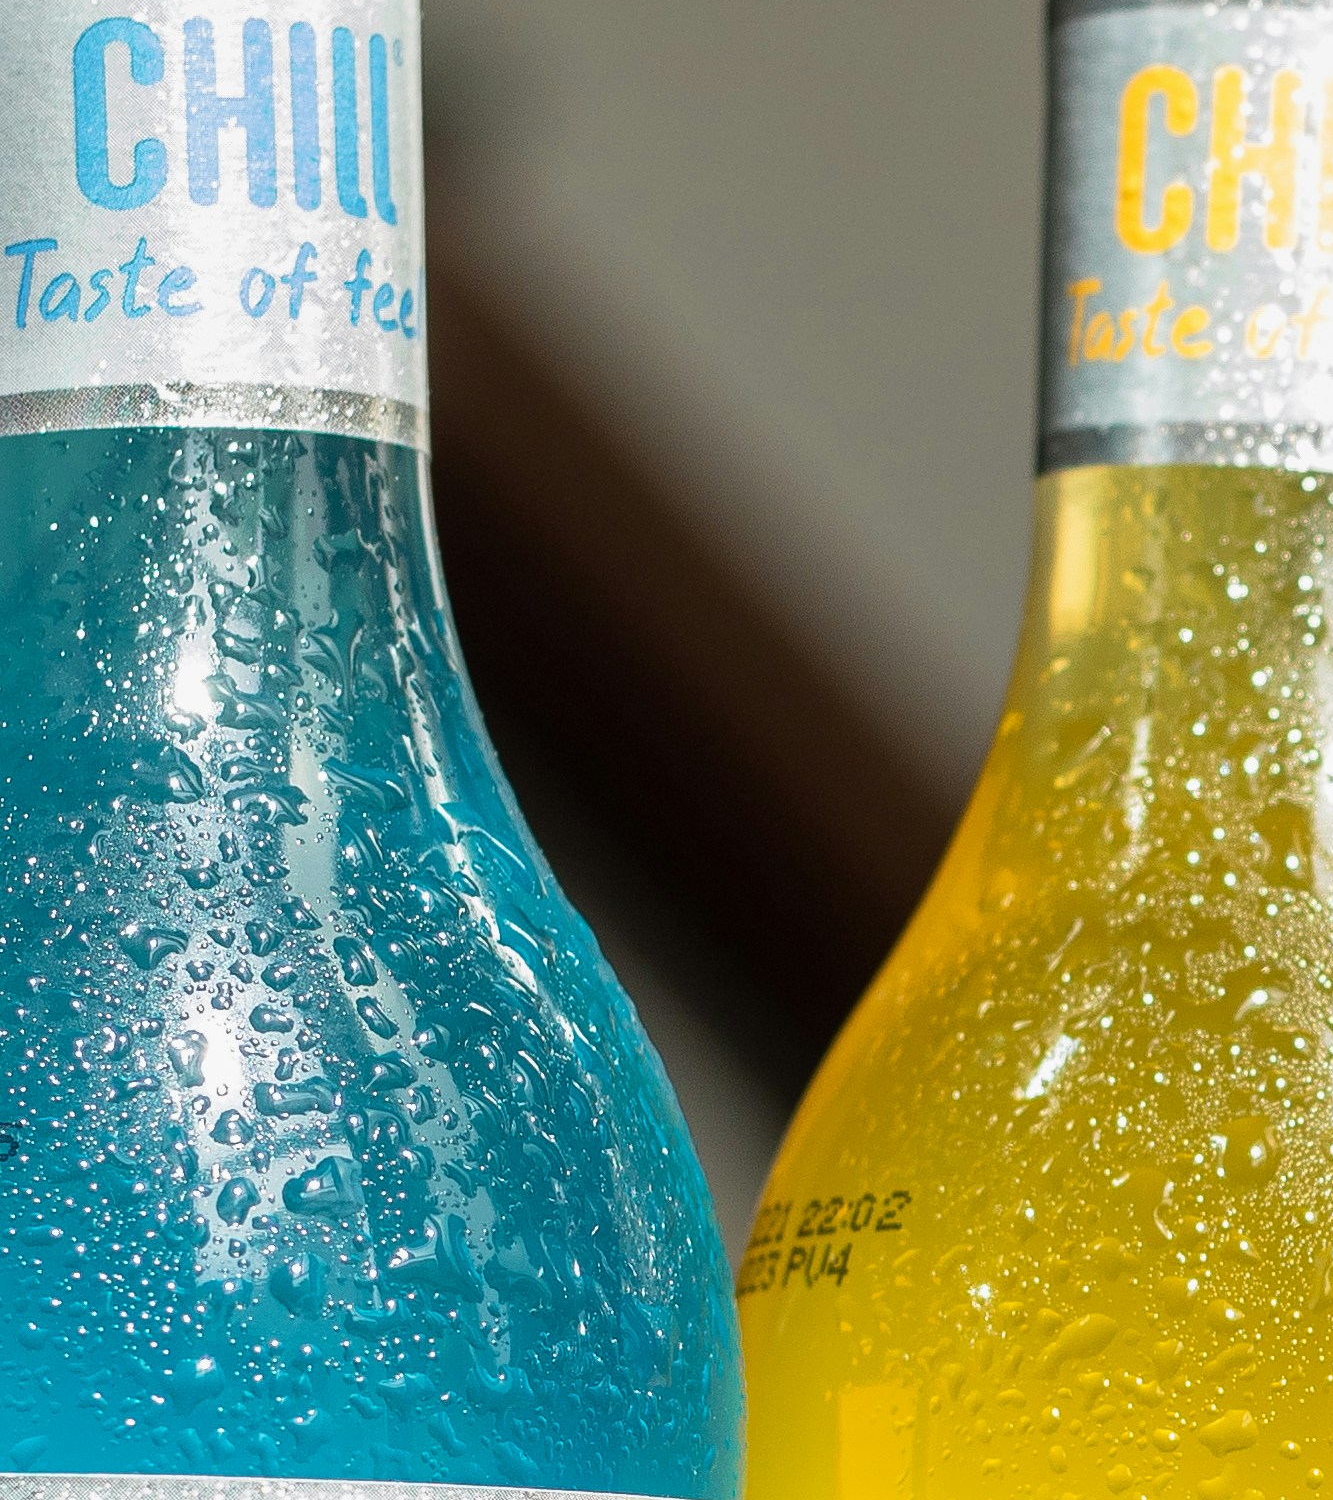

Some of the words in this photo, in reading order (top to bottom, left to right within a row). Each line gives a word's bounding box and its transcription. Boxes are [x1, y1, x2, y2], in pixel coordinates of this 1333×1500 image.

[72, 15, 398, 226] CHILL
[4, 237, 205, 331] Taste
[239, 241, 318, 320] of
[1067, 277, 1214, 369] Taste
